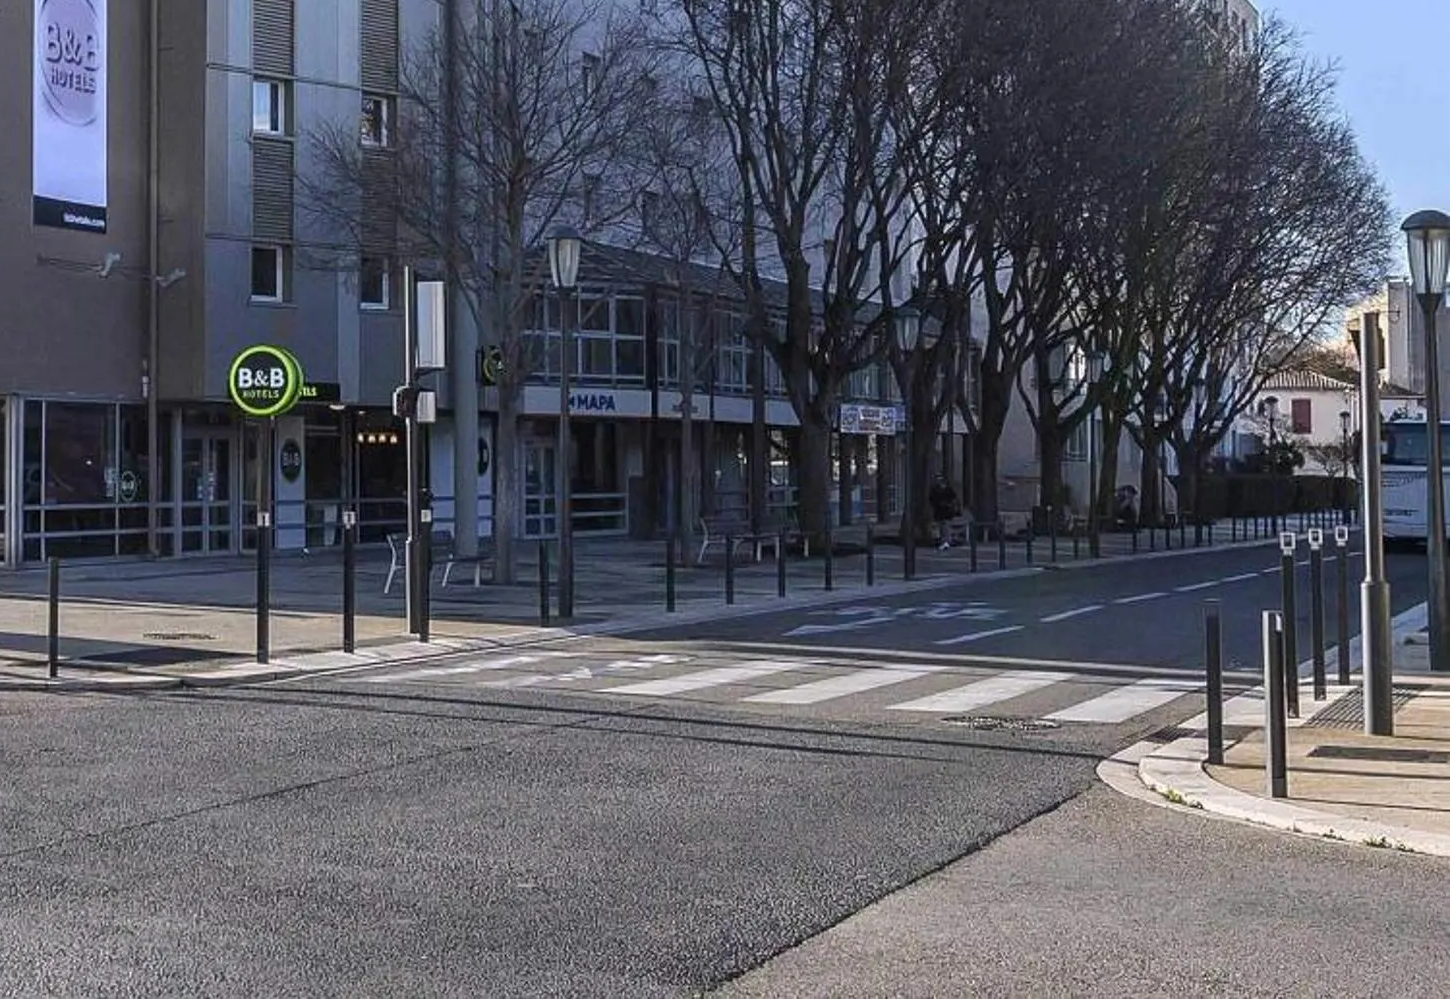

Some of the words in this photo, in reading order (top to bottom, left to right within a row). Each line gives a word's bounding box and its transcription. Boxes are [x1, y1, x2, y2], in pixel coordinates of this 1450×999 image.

[238, 367, 285, 389] B&B
[242, 389, 280, 399] HOTELS
[577, 395, 616, 411] MAPA
